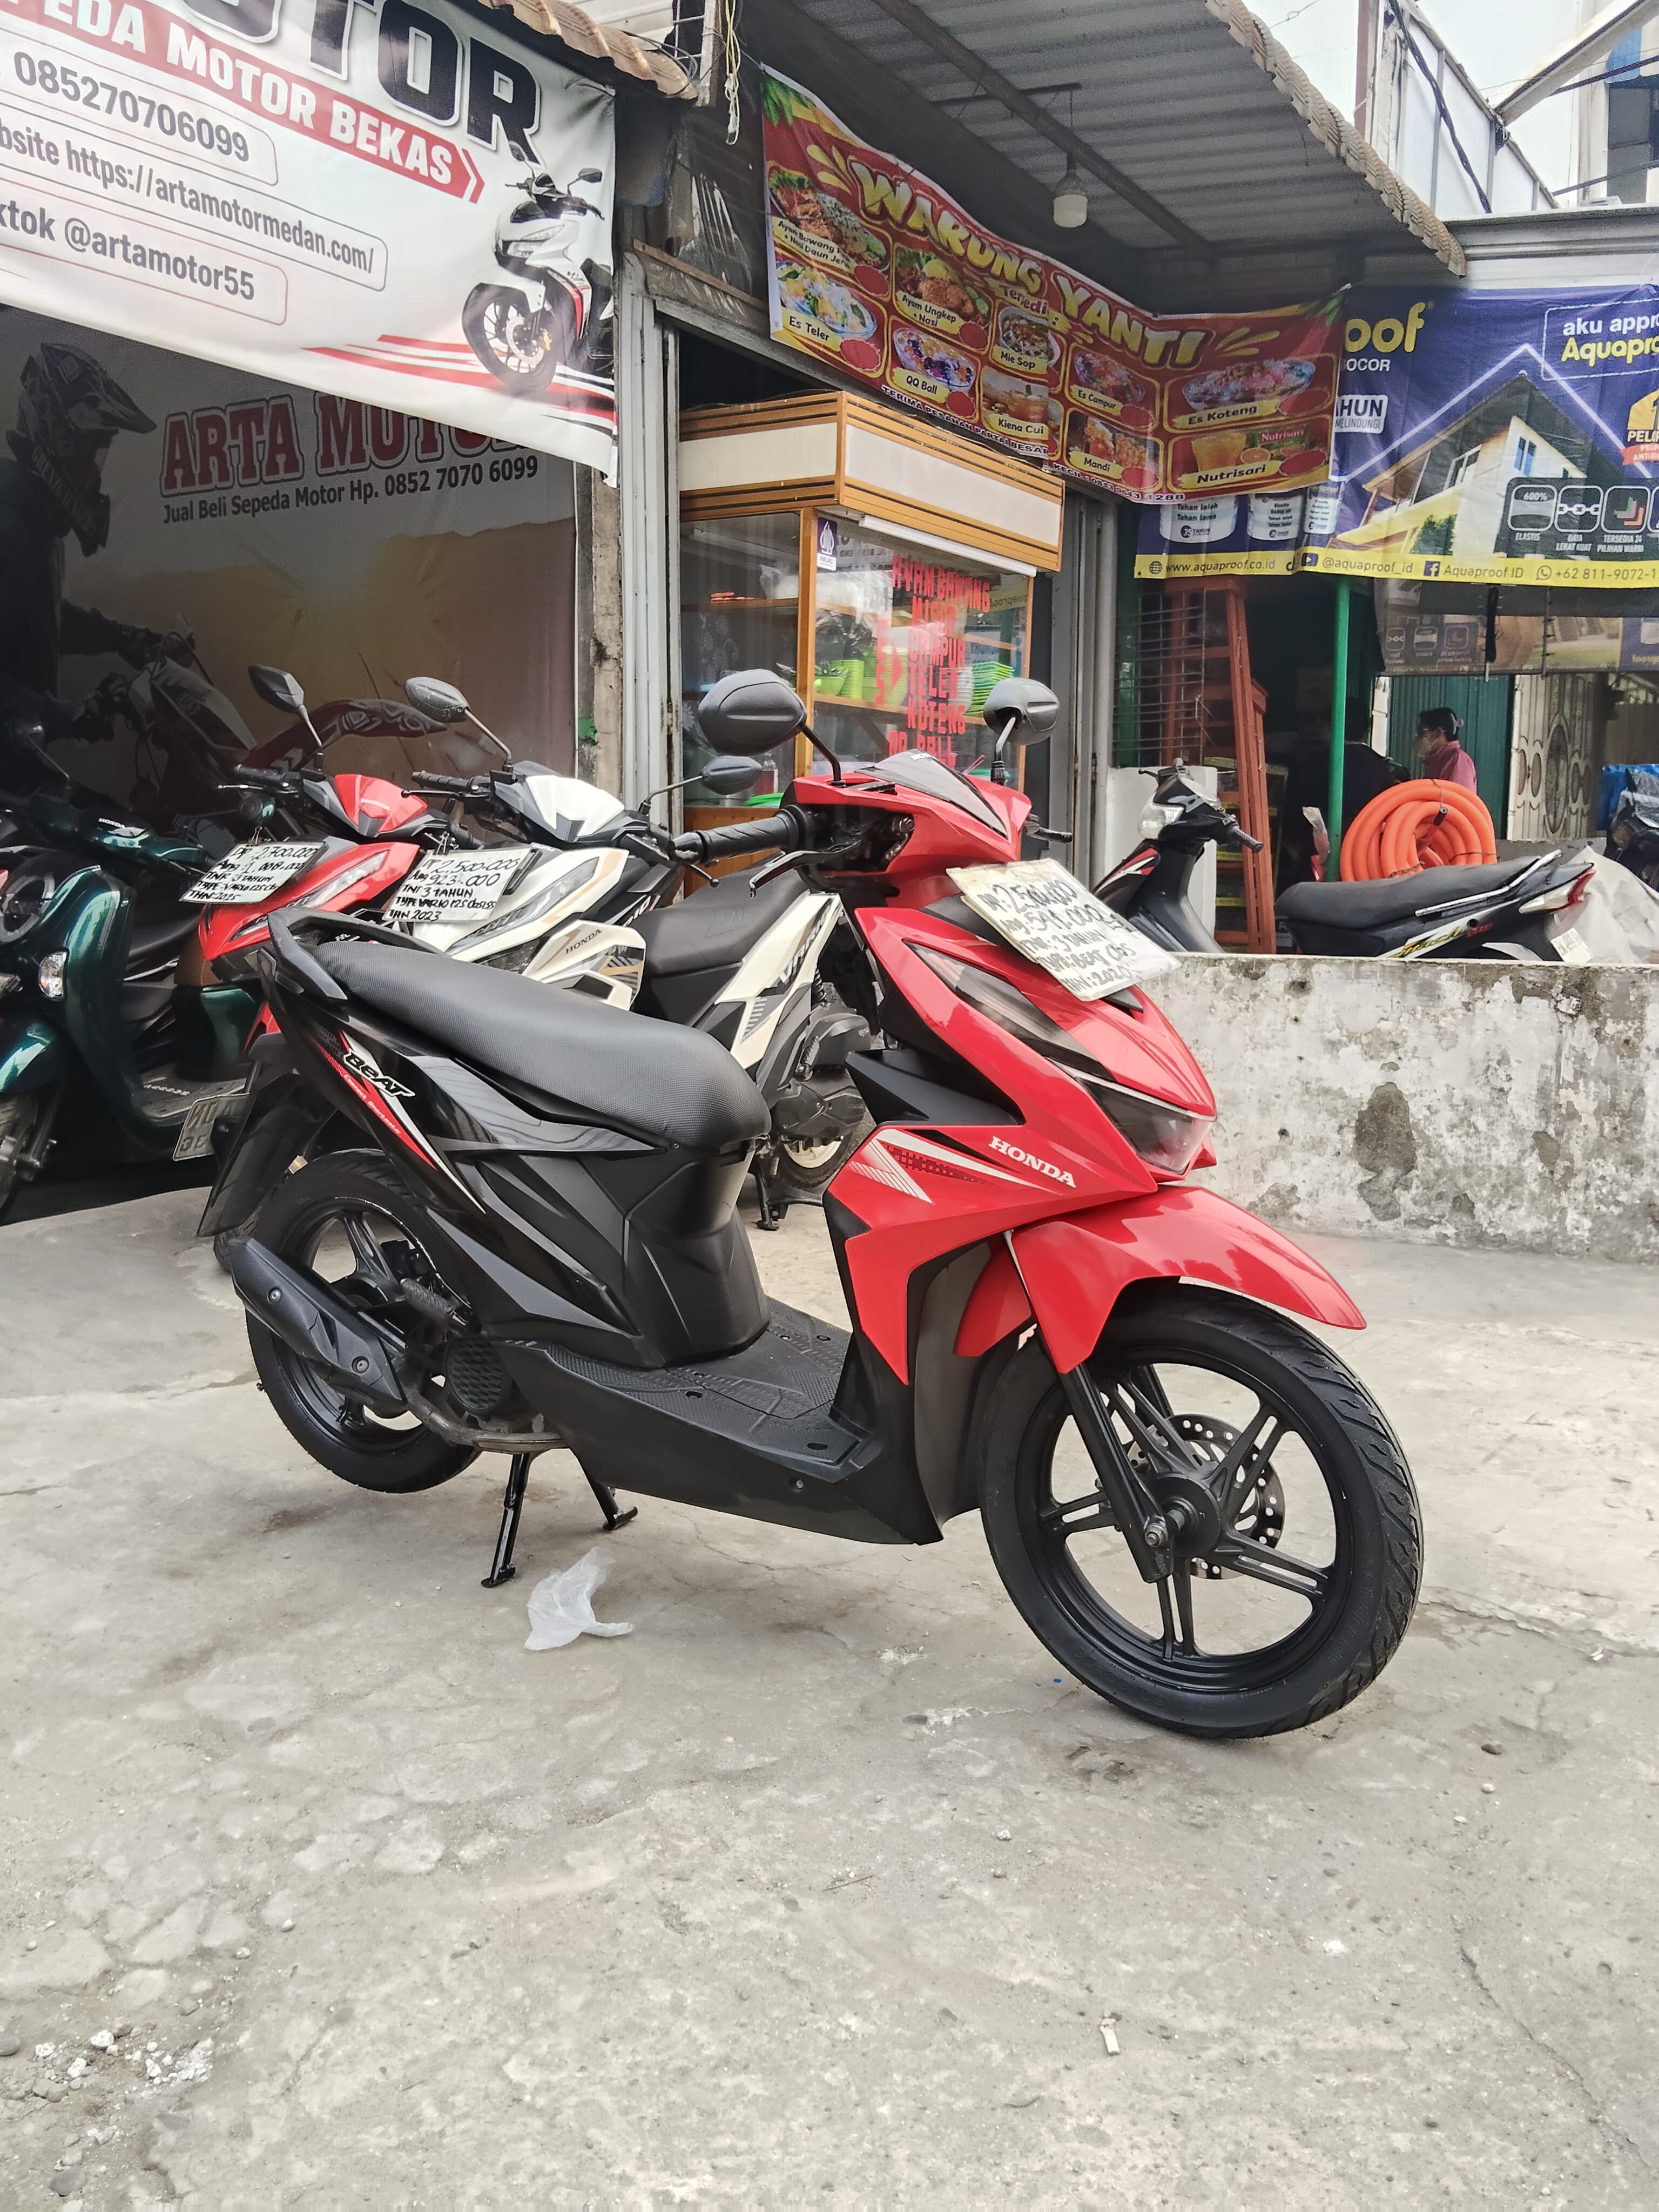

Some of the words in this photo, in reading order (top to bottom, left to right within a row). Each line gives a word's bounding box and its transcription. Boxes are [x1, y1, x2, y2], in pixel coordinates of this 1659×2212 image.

[0, 0, 146, 54] EDA
[167, 23, 316, 130] MOTOR
[330, 99, 452, 185] BEKAS
[14, 51, 249, 162] 085270706099
[65, 139, 374, 273] https://artamotormedan.com/
[64, 217, 254, 300] @artamotor55
[851, 160, 1043, 294] WARUNG
[1057, 275, 1206, 366] YANTI
[902, 294, 924, 314] Ayam
[925, 304, 956, 325] Ungkep
[789, 316, 802, 328] Es
[805, 322, 830, 342] Teler
[919, 313, 938, 327] Nasi
[1562, 317, 1603, 336] aku
[1001, 351, 1015, 363] Mie
[1017, 358, 1036, 370] Sop
[1341, 358, 1391, 372] OCOR
[906, 375, 919, 388] QQ
[921, 381, 938, 395] Ball
[1078, 390, 1087, 400] Es
[1088, 392, 1116, 410] Campur
[1189, 415, 1203, 425] Es
[1208, 406, 1257, 421] Koteng
[882, 386, 922, 410] TERIMA
[925, 405, 973, 431] PESANAN
[974, 426, 1009, 446] PARTAI
[1054, 463, 1084, 480] KECIL
[161, 395, 304, 497] ARTA
[1083, 457, 1110, 473] Mandi
[1197, 464, 1267, 484] Nutrisari
[164, 501, 194, 523] Jual
[199, 496, 227, 518] Beli
[232, 489, 290, 518] Sepeda
[295, 484, 345, 507] Motor
[350, 479, 379, 504] Hp.
[385, 470, 431, 496] 0852
[436, 463, 483, 490] 7070
[489, 455, 538, 483] 6099
[1523, 491, 1548, 501] 600%
[1166, 558, 1276, 572] www.aquaproof.co.id
[1323, 557, 1413, 575] @aquaproof_id
[1444, 566, 1509, 579] Aquaproof
[1512, 567, 1523, 578] ID
[1556, 567, 1579, 579] +62
[1583, 568, 1659, 581] 811-9072-1
[892, 555, 934, 598] AYAM
[98, 817, 125, 829] HONDA
[411, 909, 442, 920] 2023
[566, 928, 603, 954] HONDA
[988, 1136, 1076, 1188] HONDA
